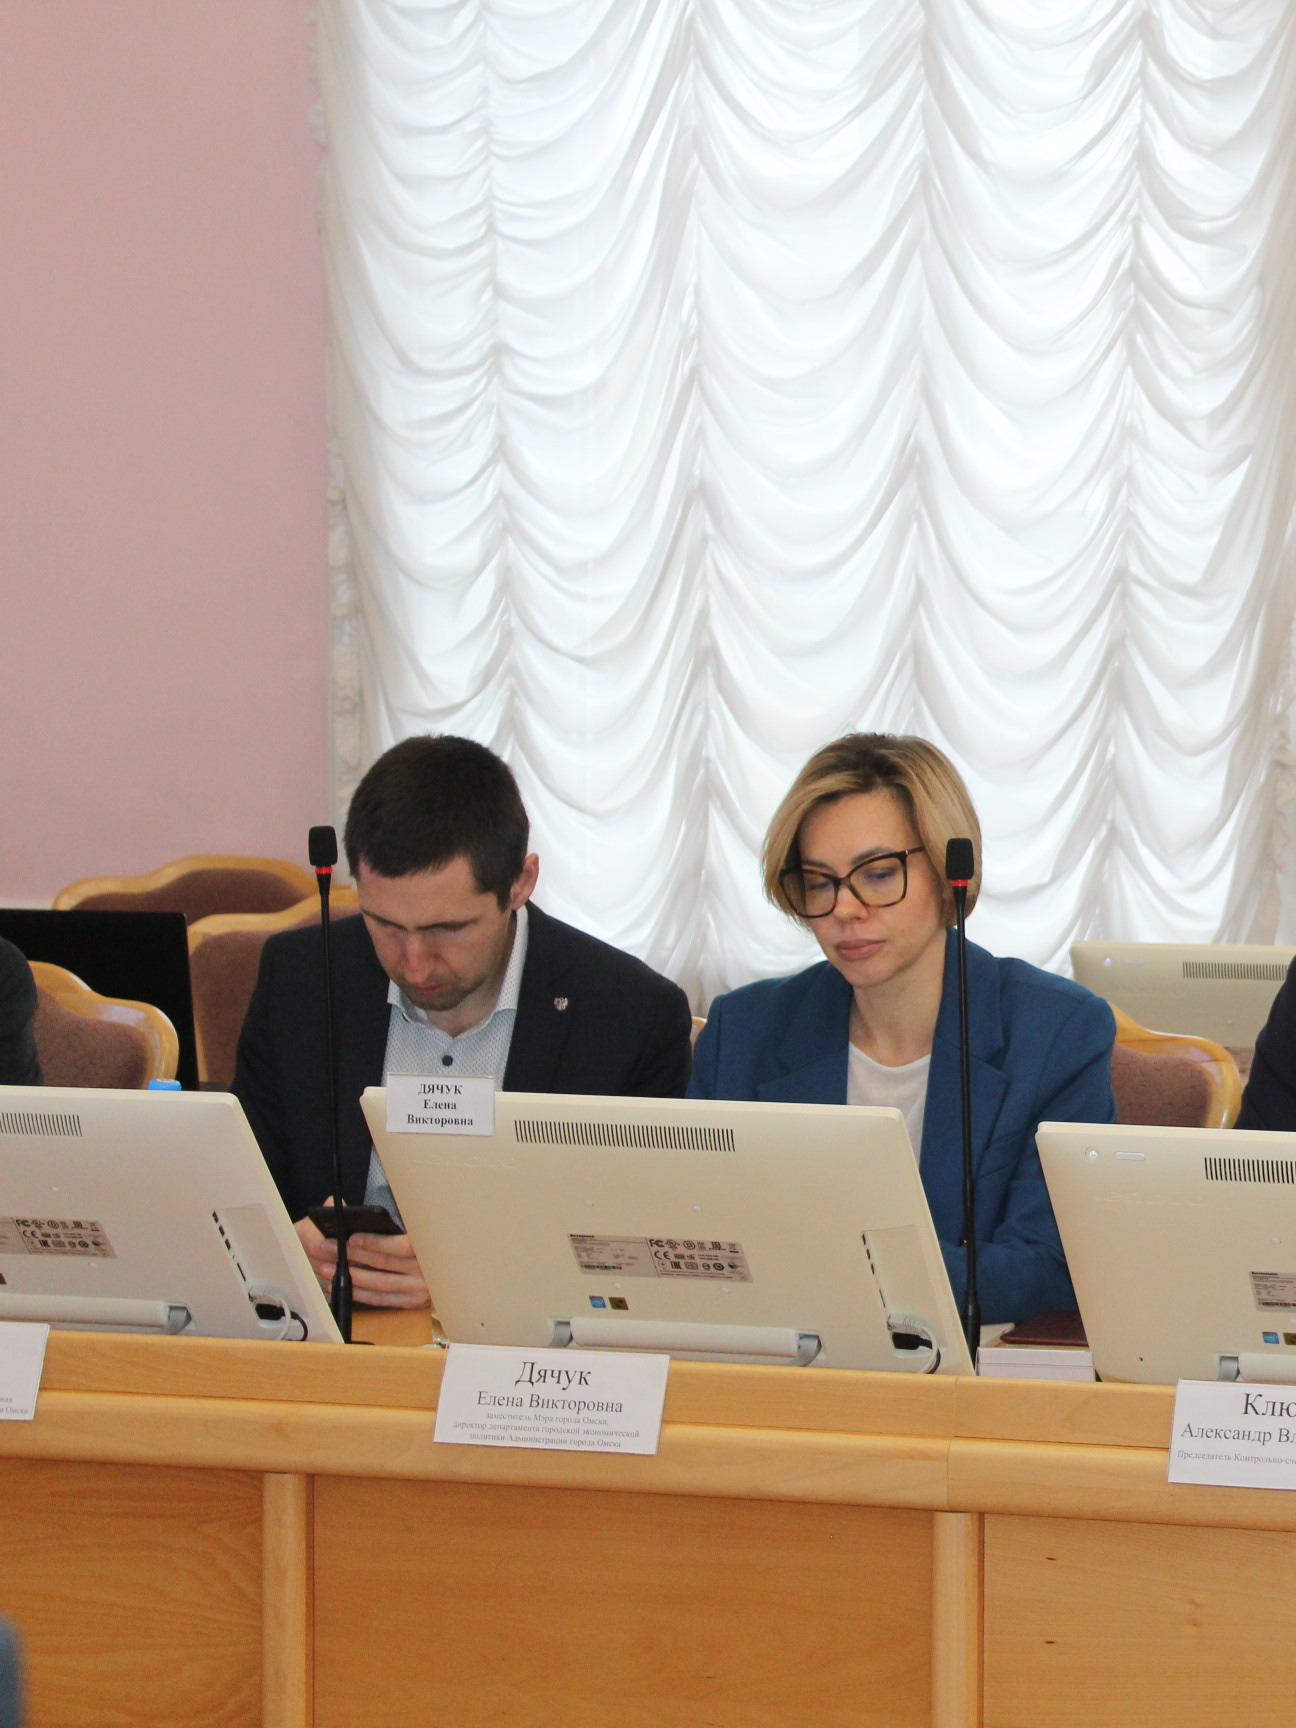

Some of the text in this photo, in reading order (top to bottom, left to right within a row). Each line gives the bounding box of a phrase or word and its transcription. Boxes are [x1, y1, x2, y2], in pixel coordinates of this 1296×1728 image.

[418, 1083, 463, 1095] ДЯЧУК
[423, 1099, 457, 1110] Елена
[407, 1113, 474, 1127] Викторовна
[514, 1361, 592, 1391] Дячук
[477, 1390, 624, 1415] Елена Викторовна
[486, 1412, 532, 1421] заместитель
[533, 1413, 554, 1424] Мэра
[555, 1416, 581, 1426] города
[453, 1421, 640, 1438] директор департамента городской экономической
[1180, 1423, 1272, 1446] Александр
[469, 1432, 621, 1448] политики Администрации города Омска
[1177, 1449, 1232, 1462] Председатель
